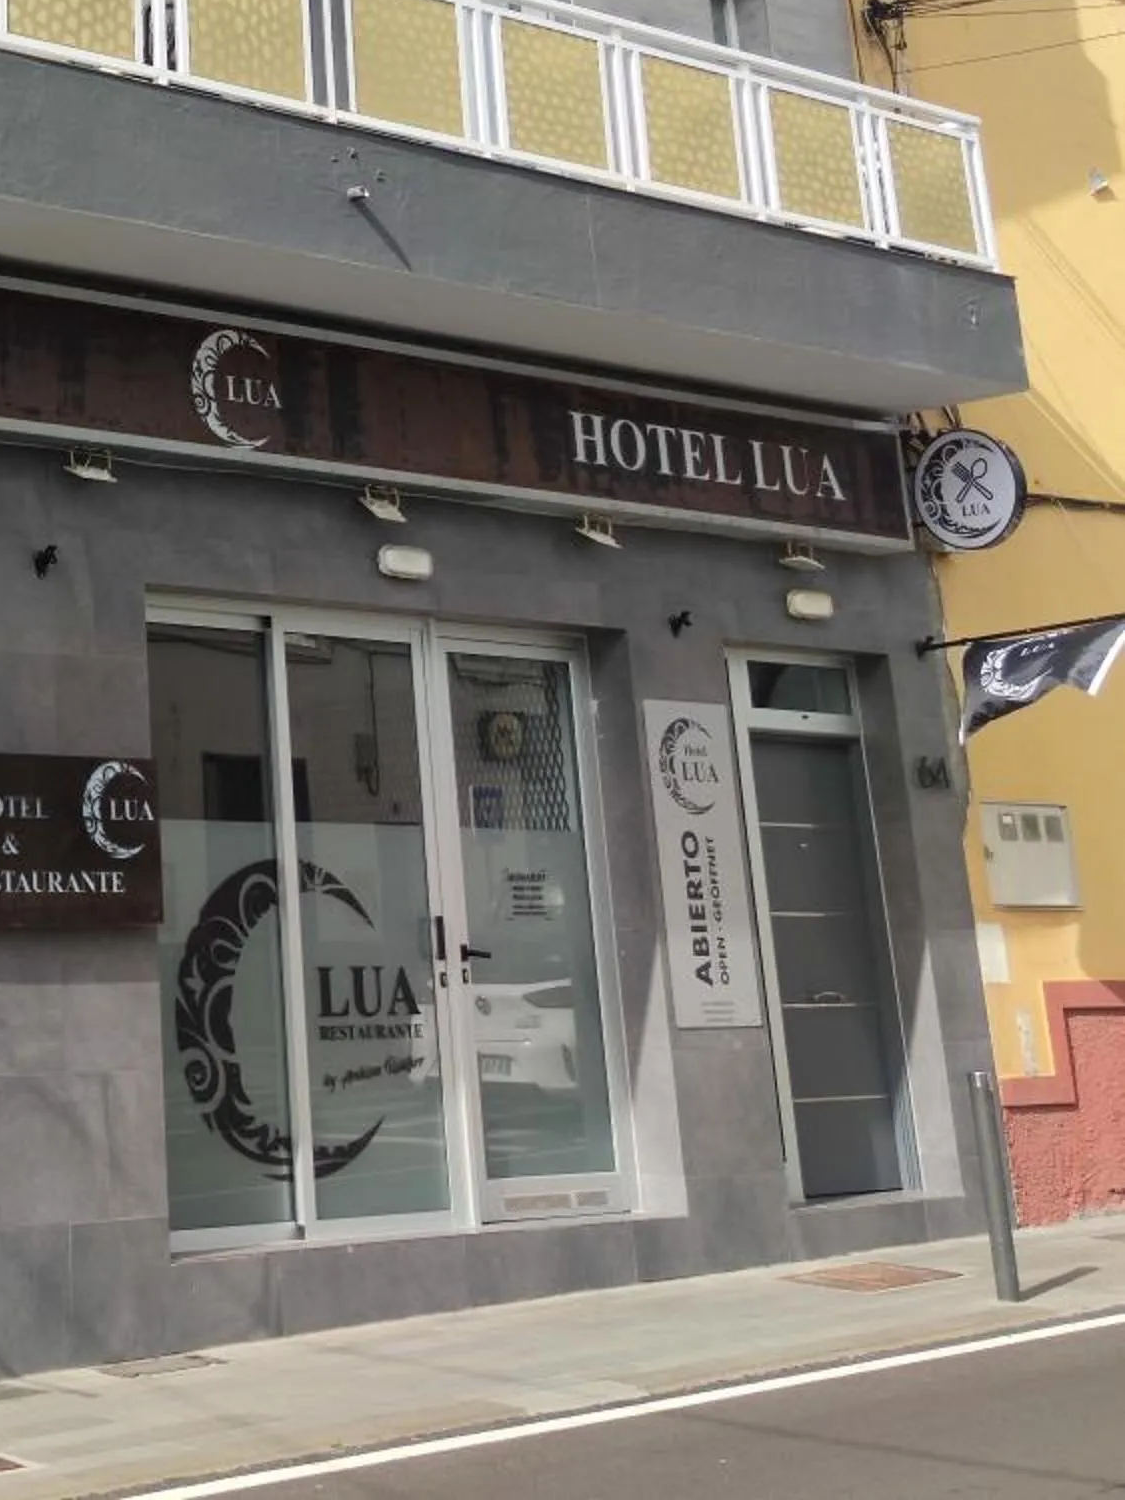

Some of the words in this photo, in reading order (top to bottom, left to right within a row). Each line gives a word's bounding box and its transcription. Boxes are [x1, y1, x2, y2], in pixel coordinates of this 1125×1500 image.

[226, 375, 283, 409] LUA
[568, 410, 742, 486] HOTEL
[749, 439, 846, 501] LUA
[962, 503, 991, 518] LUA
[681, 761, 719, 783] LUA
[109, 799, 155, 821] LUA
[1, 833, 19, 855] &
[680, 830, 713, 987] ABIERTO
[716, 936, 730, 986] OPEN
[316, 965, 422, 1017] LUA
[317, 1023, 426, 1041] RESTAURANTE
